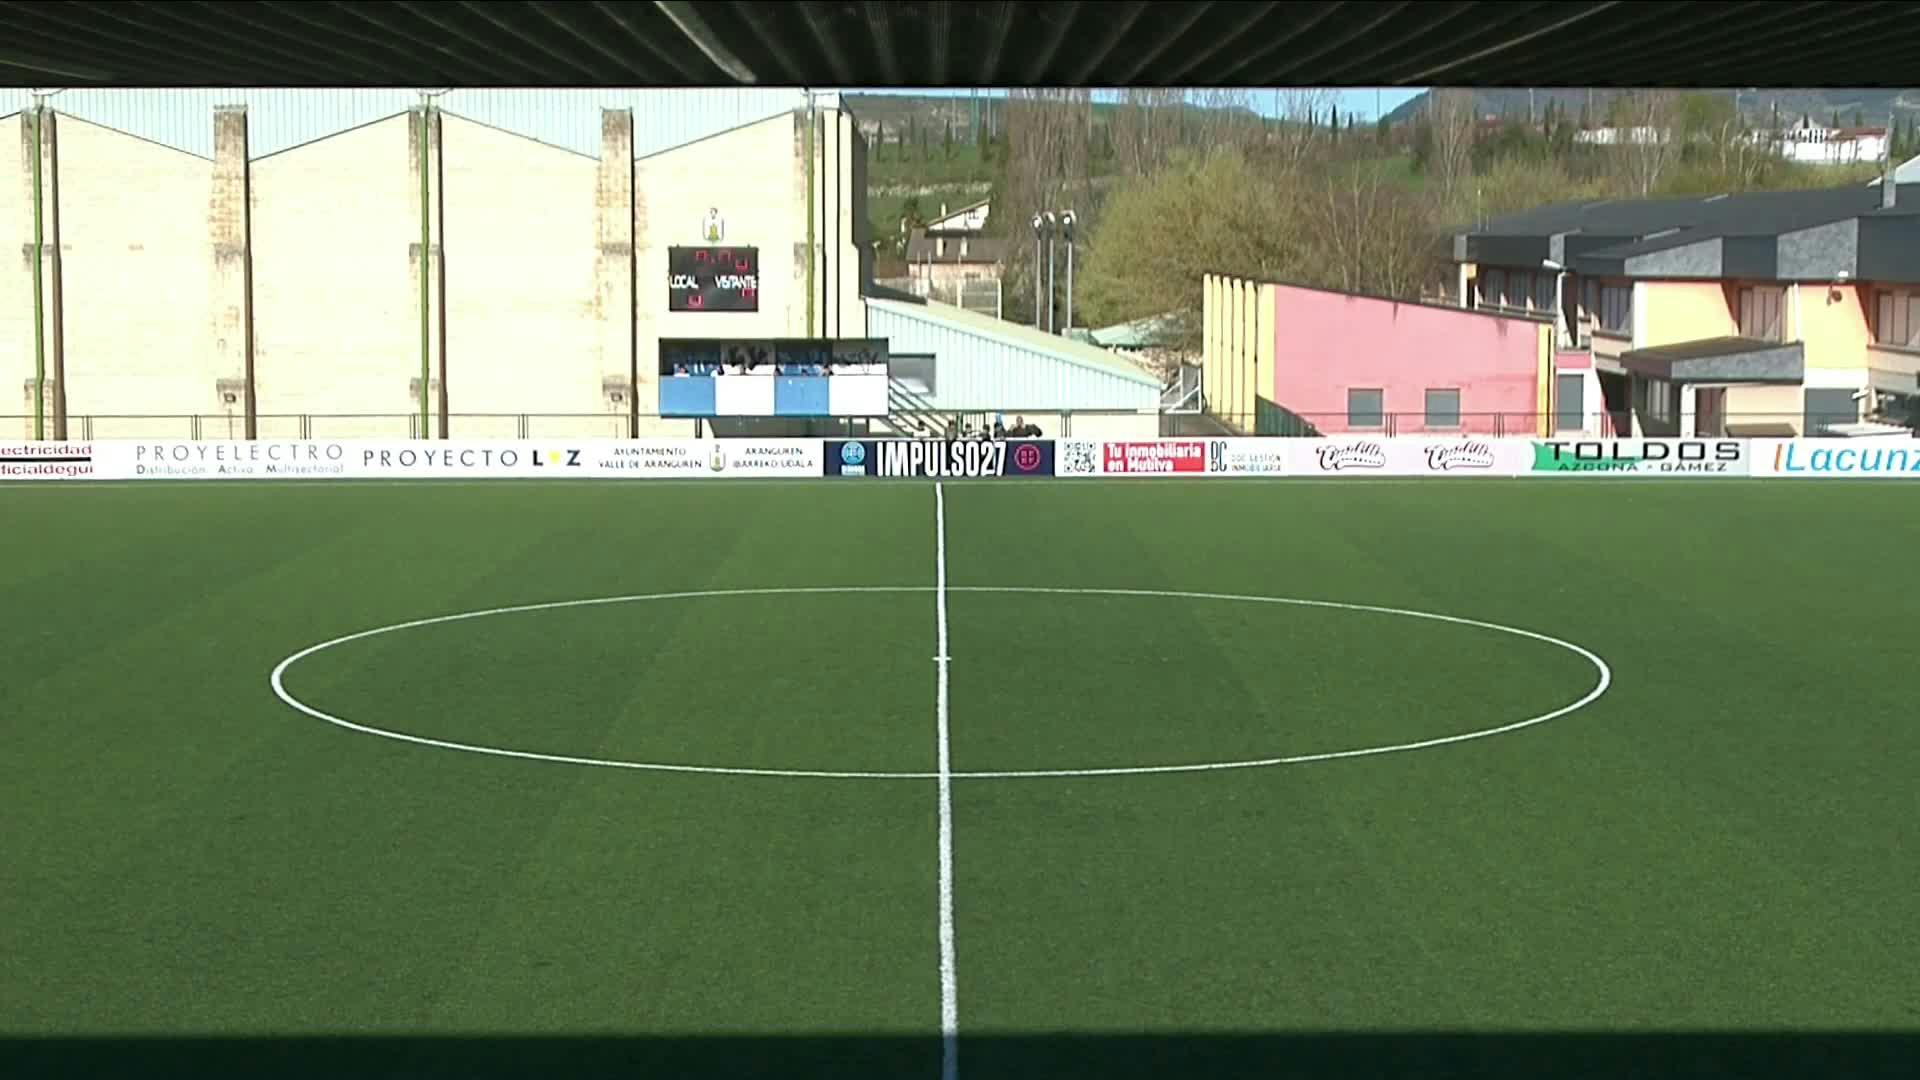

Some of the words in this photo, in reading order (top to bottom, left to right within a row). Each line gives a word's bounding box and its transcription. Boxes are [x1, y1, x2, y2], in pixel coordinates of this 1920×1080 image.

[670, 275, 698, 289] LOCAL
[715, 275, 757, 289] VISITANTE
[136, 445, 343, 461] PROYELECTRO
[363, 449, 518, 467] PROYECTO
[1107, 443, 1122, 458] Tu
[1545, 442, 1740, 461] TOLDOS
[1107, 459, 1124, 472] en
